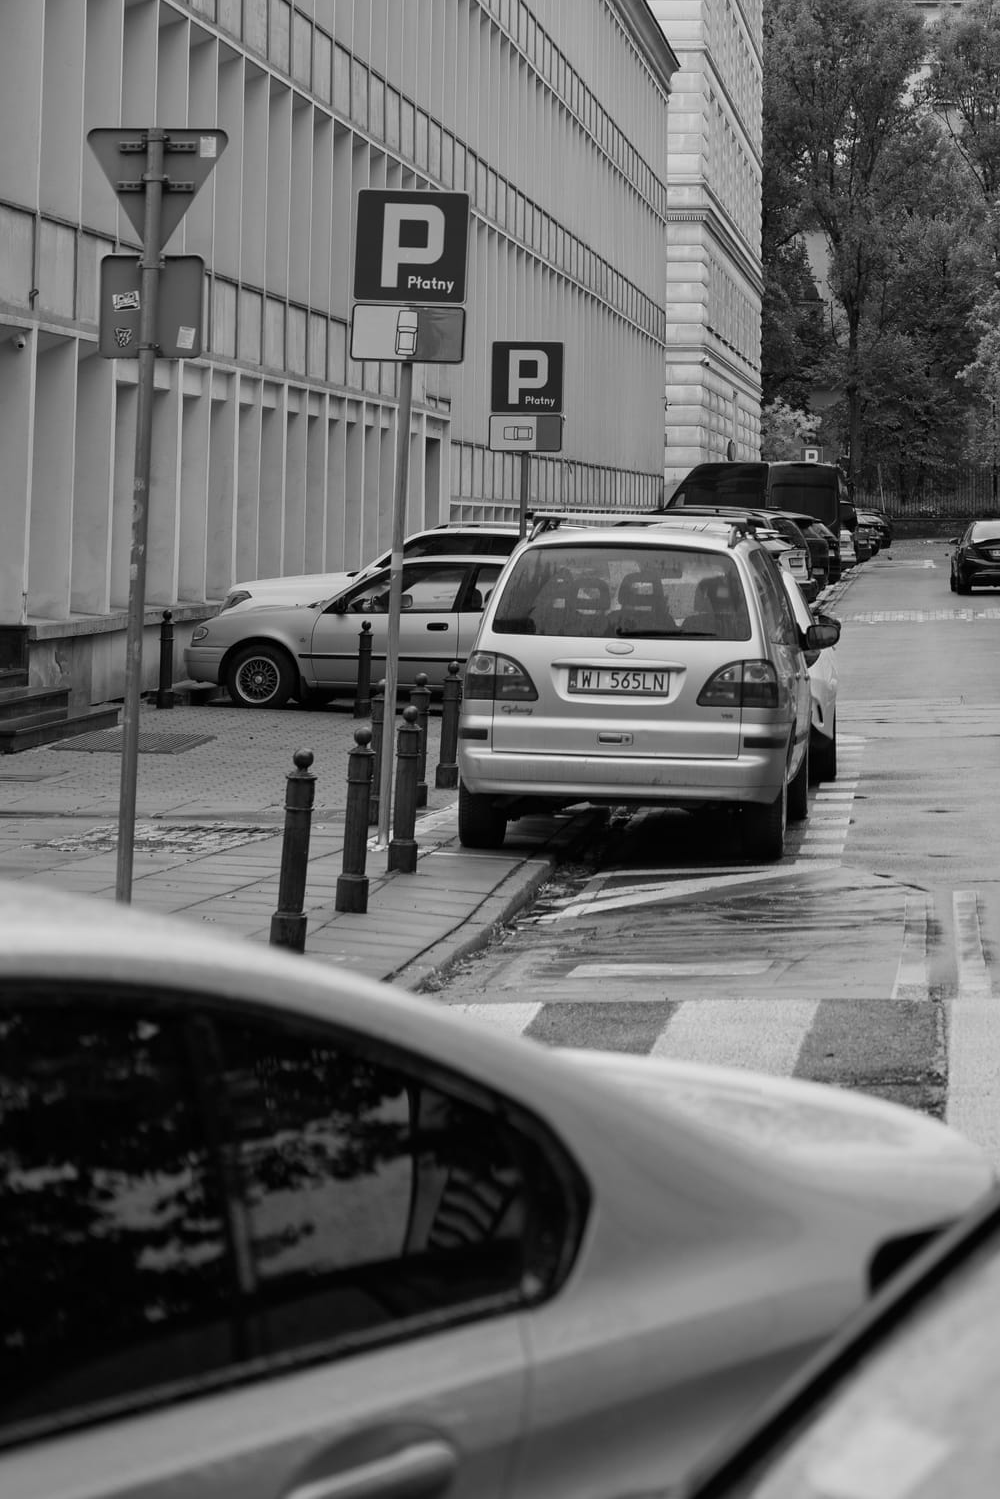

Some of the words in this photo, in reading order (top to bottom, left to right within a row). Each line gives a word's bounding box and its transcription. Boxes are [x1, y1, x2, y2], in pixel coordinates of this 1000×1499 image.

[381, 202, 446, 288] P
[407, 275, 455, 294] Płatny
[508, 348, 549, 405] P
[524, 395, 556, 408] Płatny
[582, 671, 600, 688] WI
[610, 671, 664, 691] 565LN
